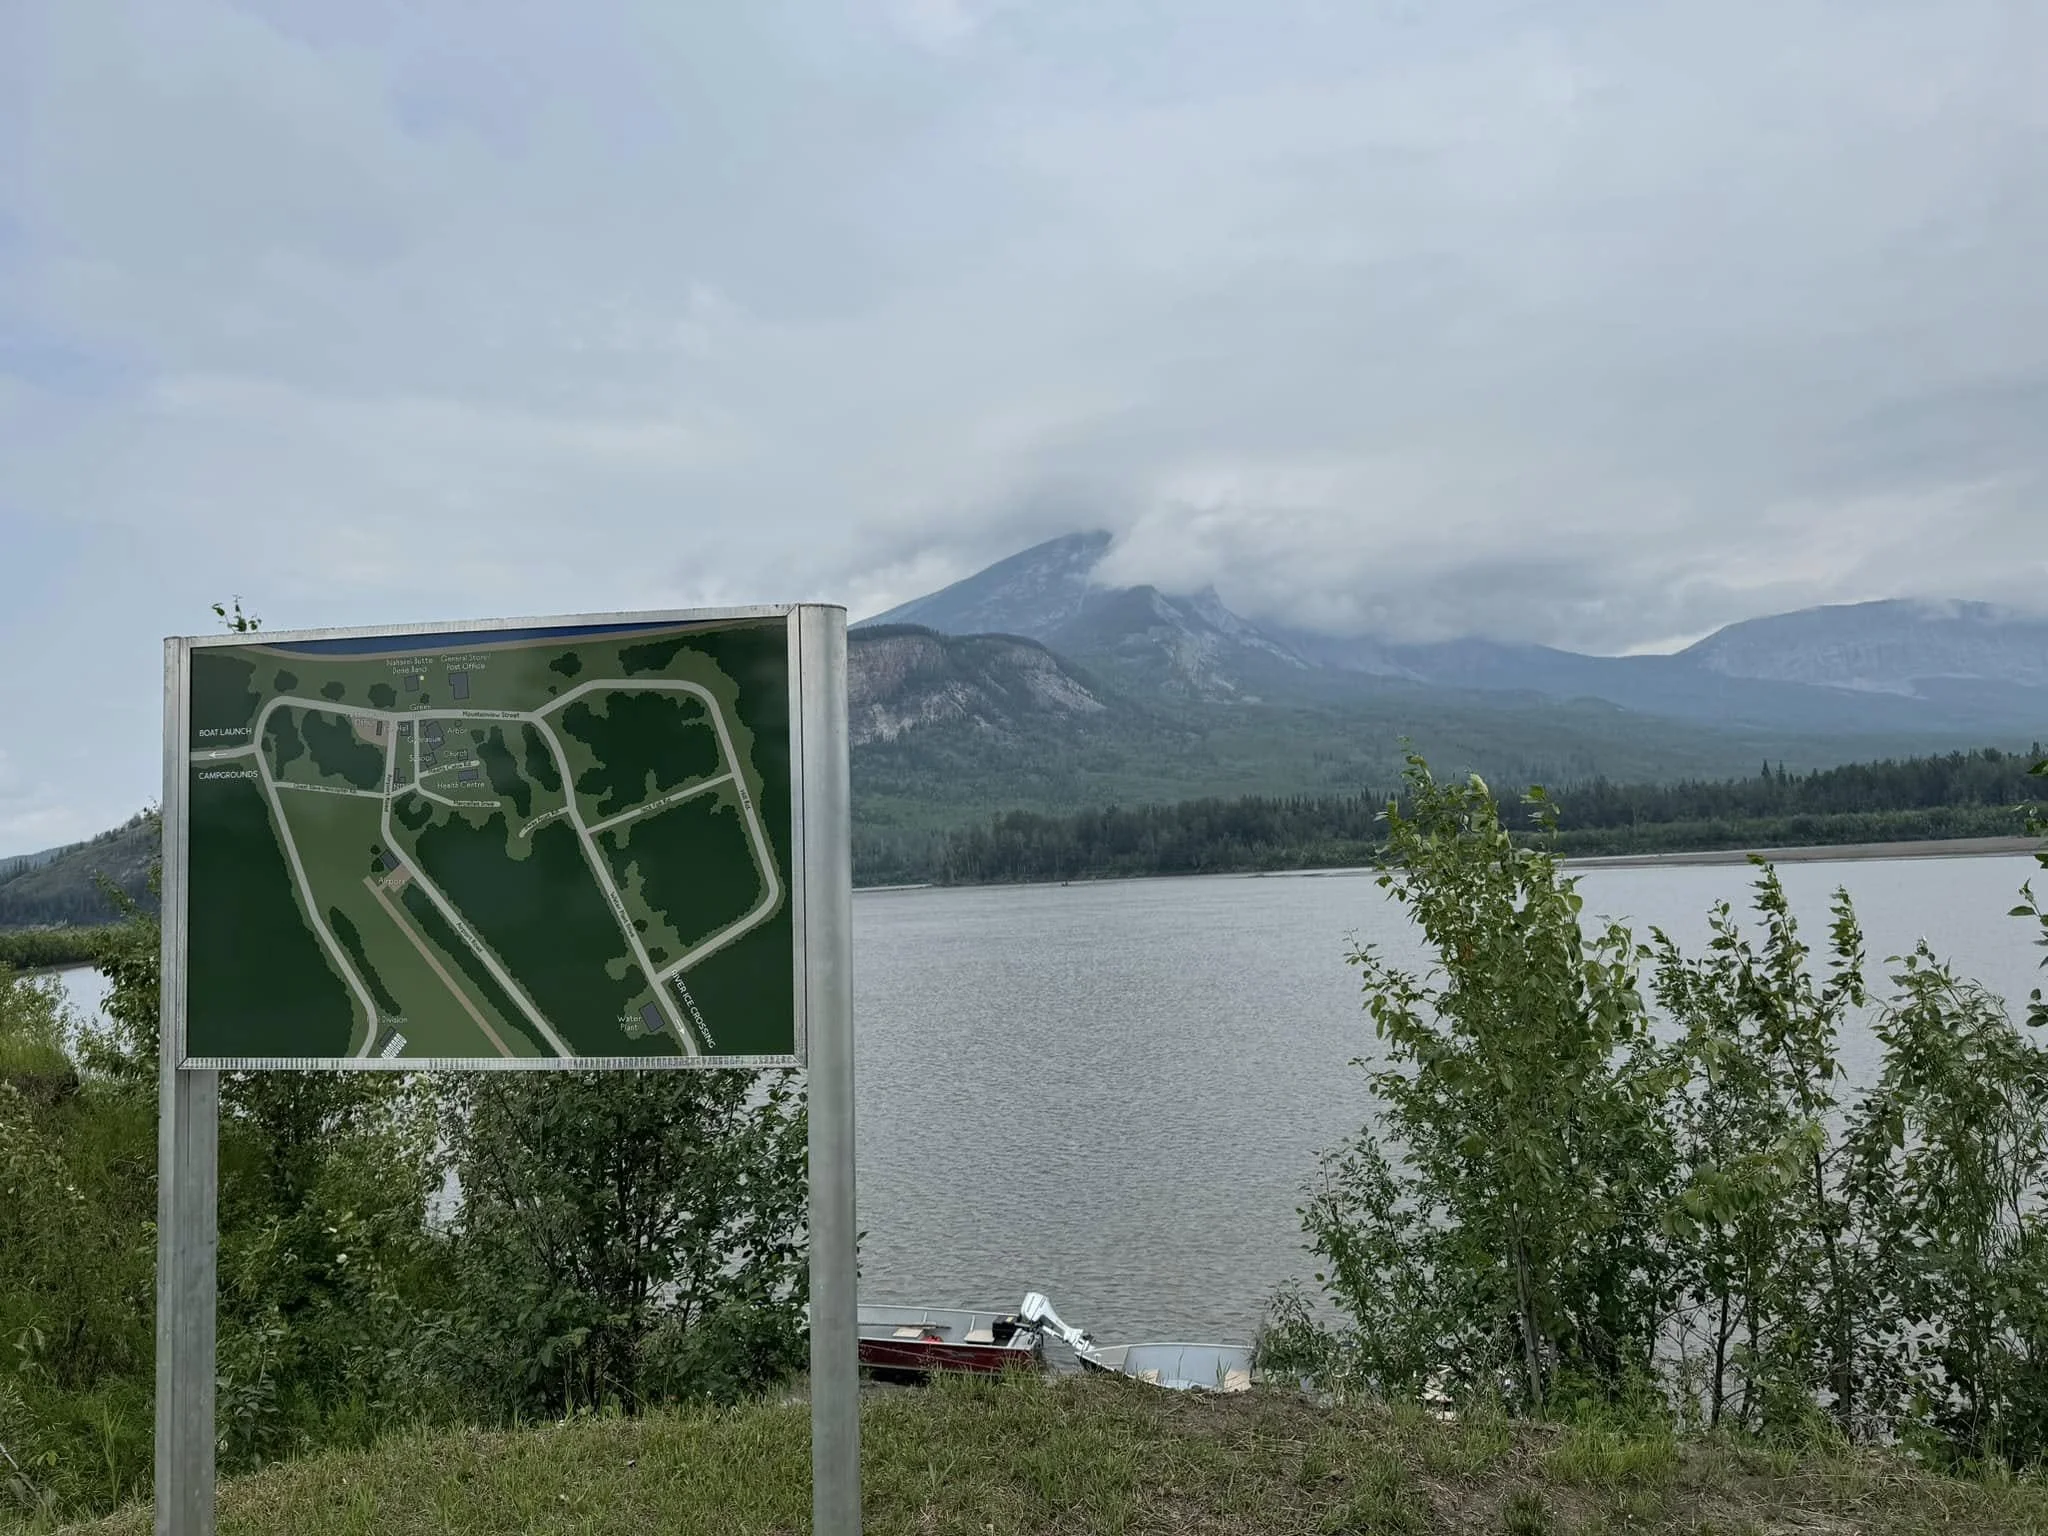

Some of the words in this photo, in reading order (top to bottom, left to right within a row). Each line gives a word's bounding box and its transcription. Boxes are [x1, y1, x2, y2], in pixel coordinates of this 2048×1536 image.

[199, 728, 219, 737] BOAT
[220, 727, 252, 736] LAUNCH
[198, 770, 258, 780] CAMPGROUNDS
[378, 876, 406, 887] Airport
[608, 889, 622, 910] Water
[454, 921, 473, 942] Airport
[469, 938, 483, 953] Road
[672, 969, 689, 994] RIVER
[682, 992, 696, 1008] ICE
[690, 1006, 716, 1049] CROSSING
[617, 1015, 641, 1023] Water
[620, 1023, 638, 1032] Plant
